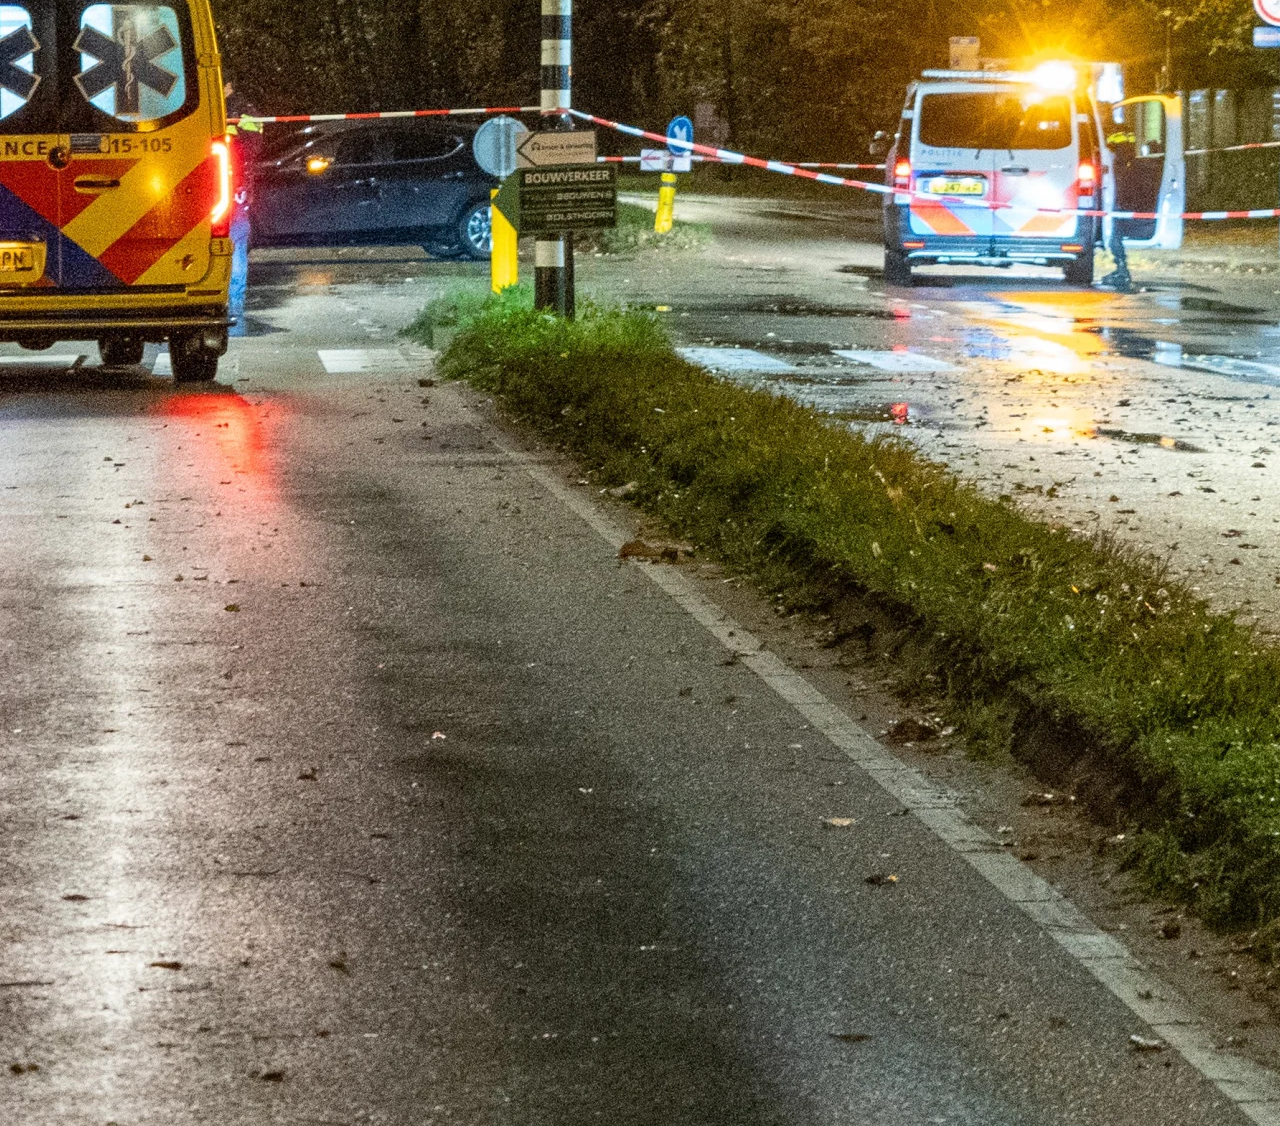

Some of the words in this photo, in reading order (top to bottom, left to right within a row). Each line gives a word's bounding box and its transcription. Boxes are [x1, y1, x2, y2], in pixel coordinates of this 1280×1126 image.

[110, 137, 172, 154] 15-105
[921, 148, 963, 158] POLITIE
[524, 170, 610, 184] BOUWVERKEER
